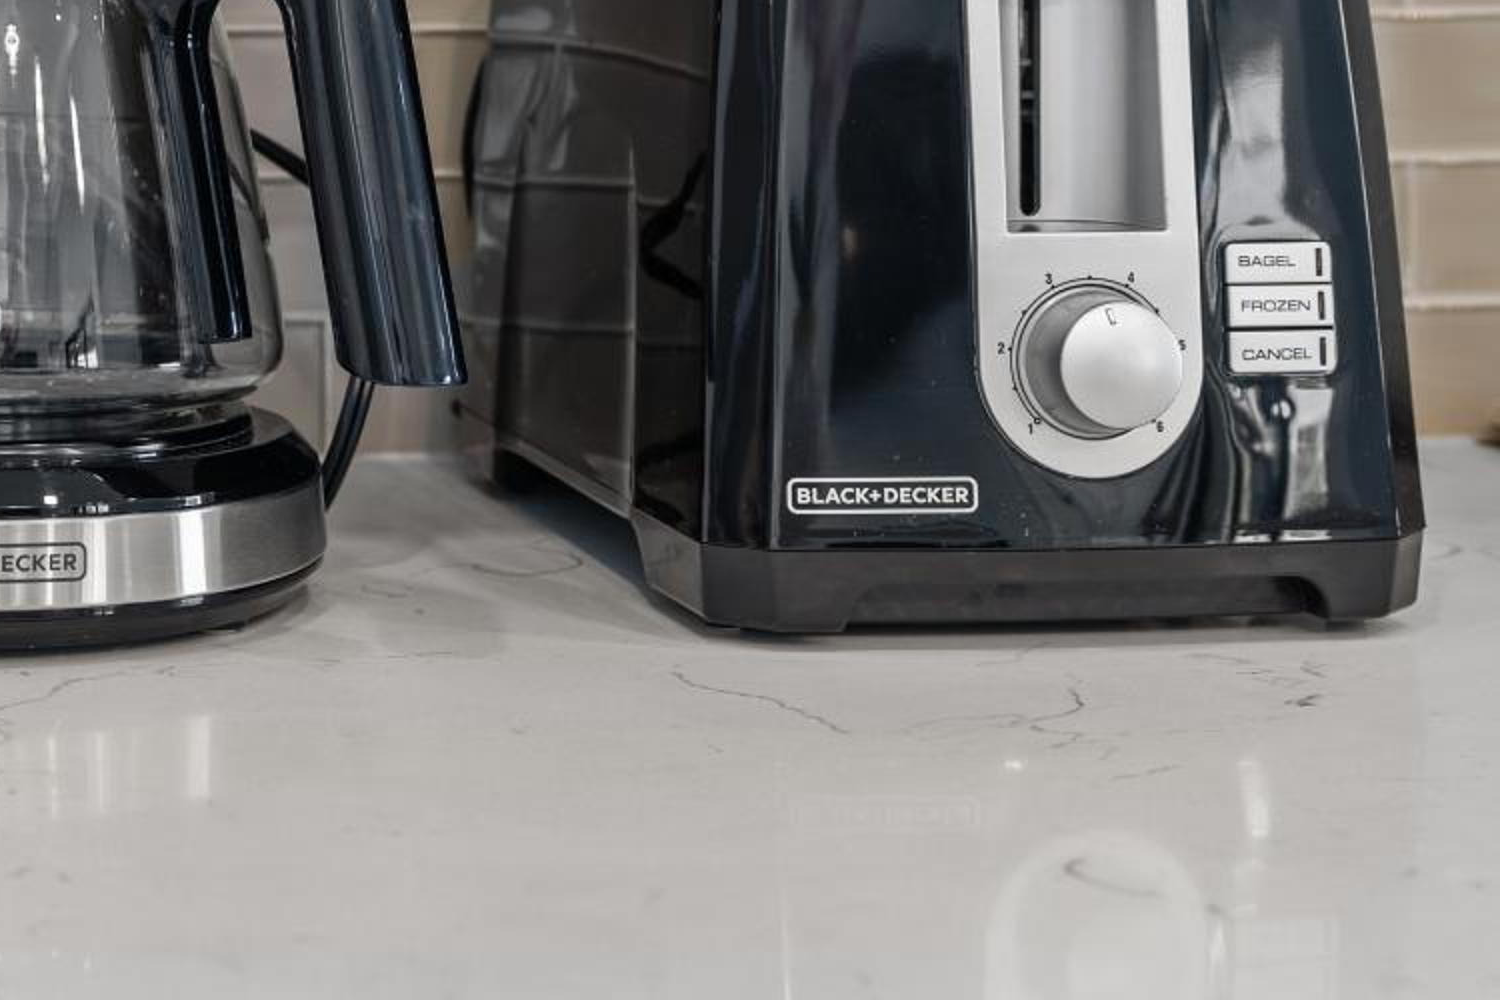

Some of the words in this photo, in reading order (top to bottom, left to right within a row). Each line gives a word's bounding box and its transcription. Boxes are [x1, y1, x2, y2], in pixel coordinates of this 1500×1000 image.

[1238, 253, 1296, 267] BAGEL
[1045, 272, 1053, 285] 3
[1128, 271, 1136, 285] 4
[1241, 300, 1312, 313] FROZEN
[997, 342, 1007, 355] 2
[1179, 338, 1187, 351] 5
[1242, 347, 1314, 362] CANCEL
[1028, 422, 1035, 434] 1
[1156, 420, 1165, 433] 6
[796, 486, 970, 505] BLACK+DECKER
